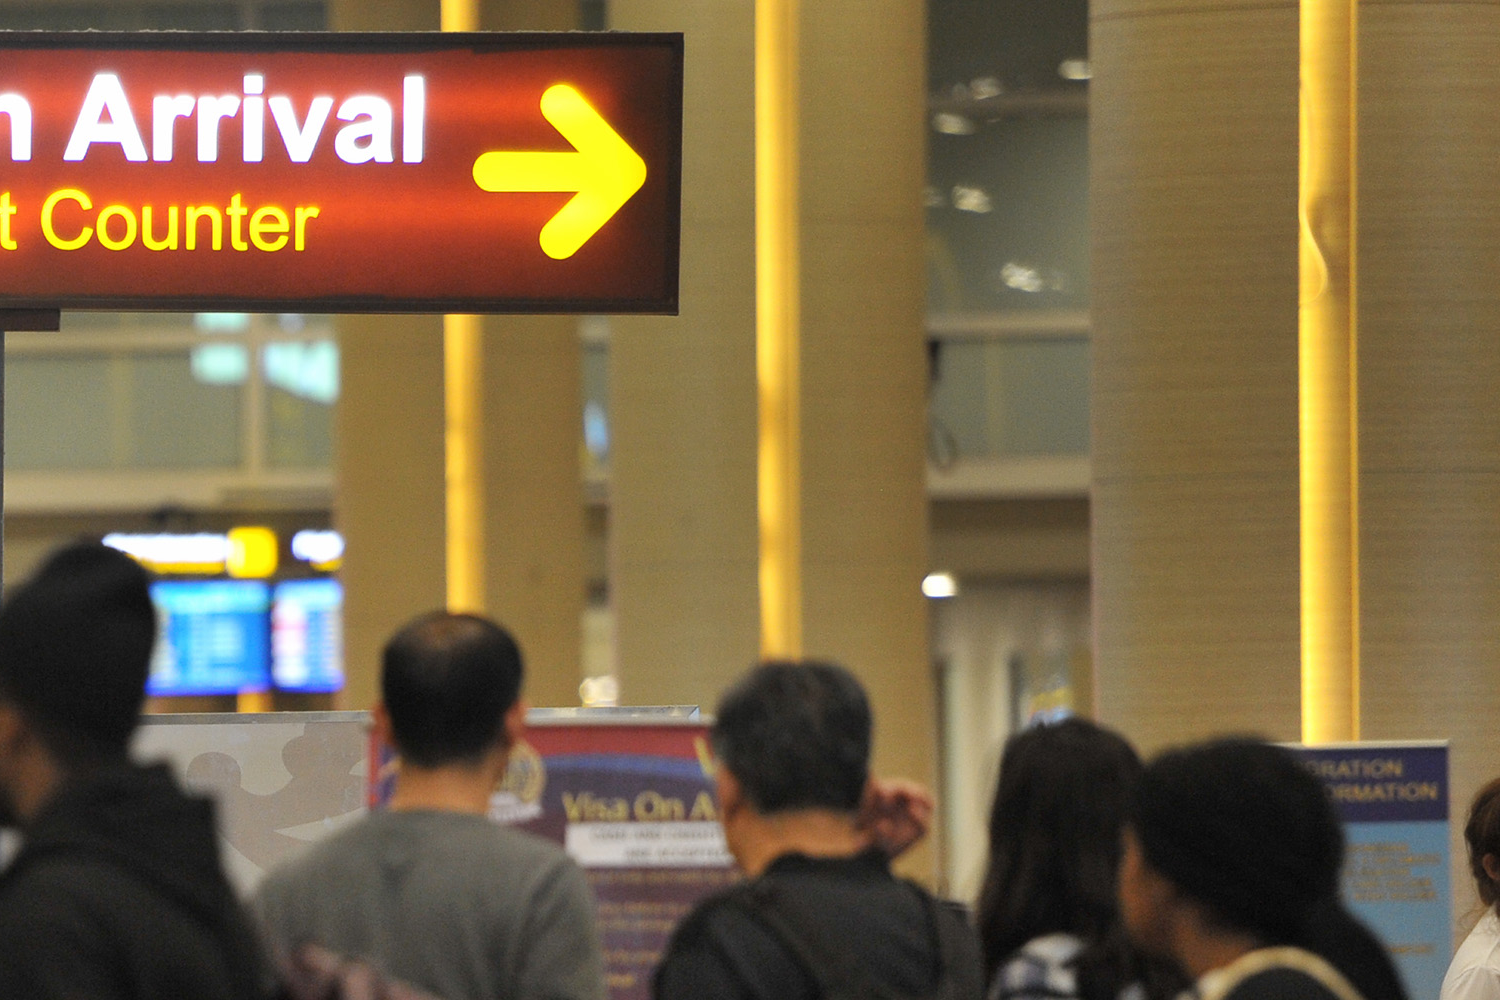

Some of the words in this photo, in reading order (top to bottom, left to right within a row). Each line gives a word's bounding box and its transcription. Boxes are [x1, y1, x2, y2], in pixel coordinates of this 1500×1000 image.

[63, 74, 427, 165] Arrival
[39, 189, 322, 254] Counter
[561, 791, 630, 822] Visa
[633, 789, 685, 822] On
